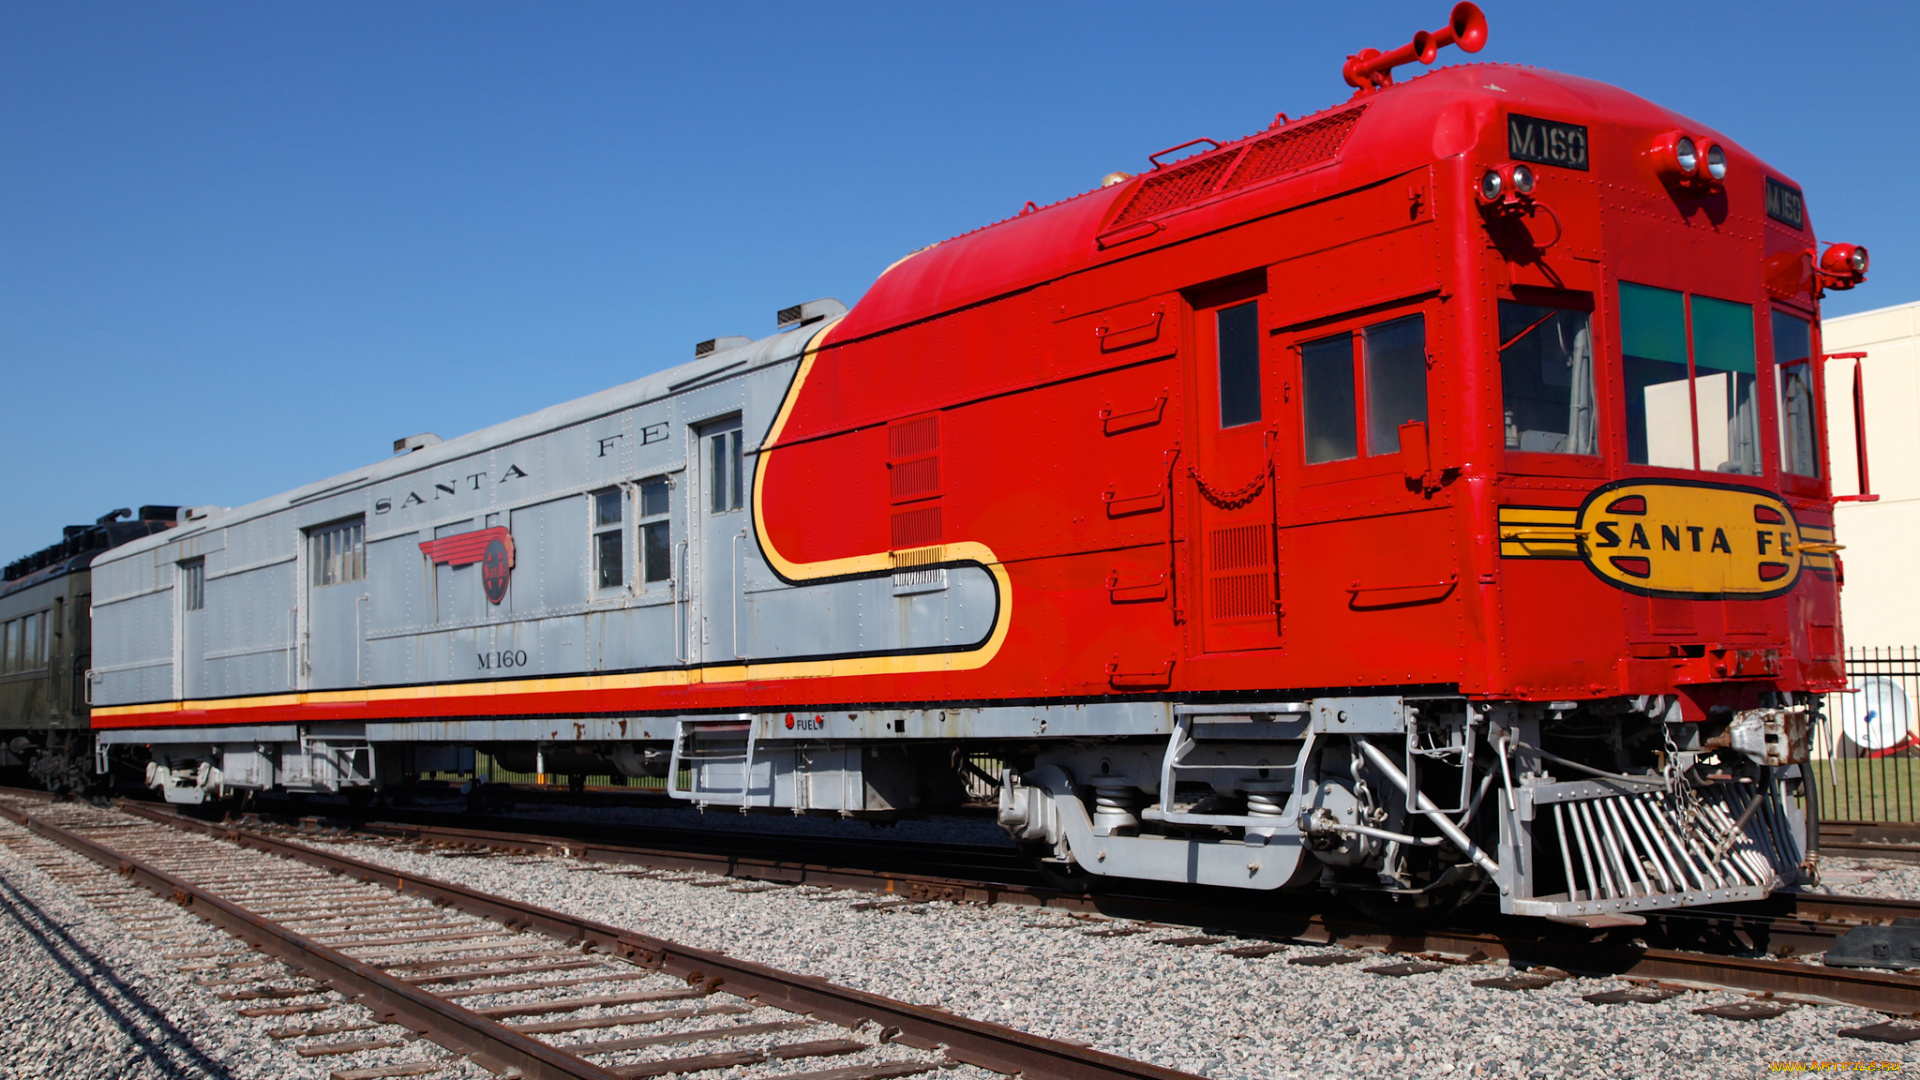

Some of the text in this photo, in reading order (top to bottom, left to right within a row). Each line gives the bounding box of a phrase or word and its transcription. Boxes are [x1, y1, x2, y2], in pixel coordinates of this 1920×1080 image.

[375, 421, 670, 515] SANTA FE
[1595, 521, 1794, 557] SANTA FE
[796, 719, 818, 731] FUEL
